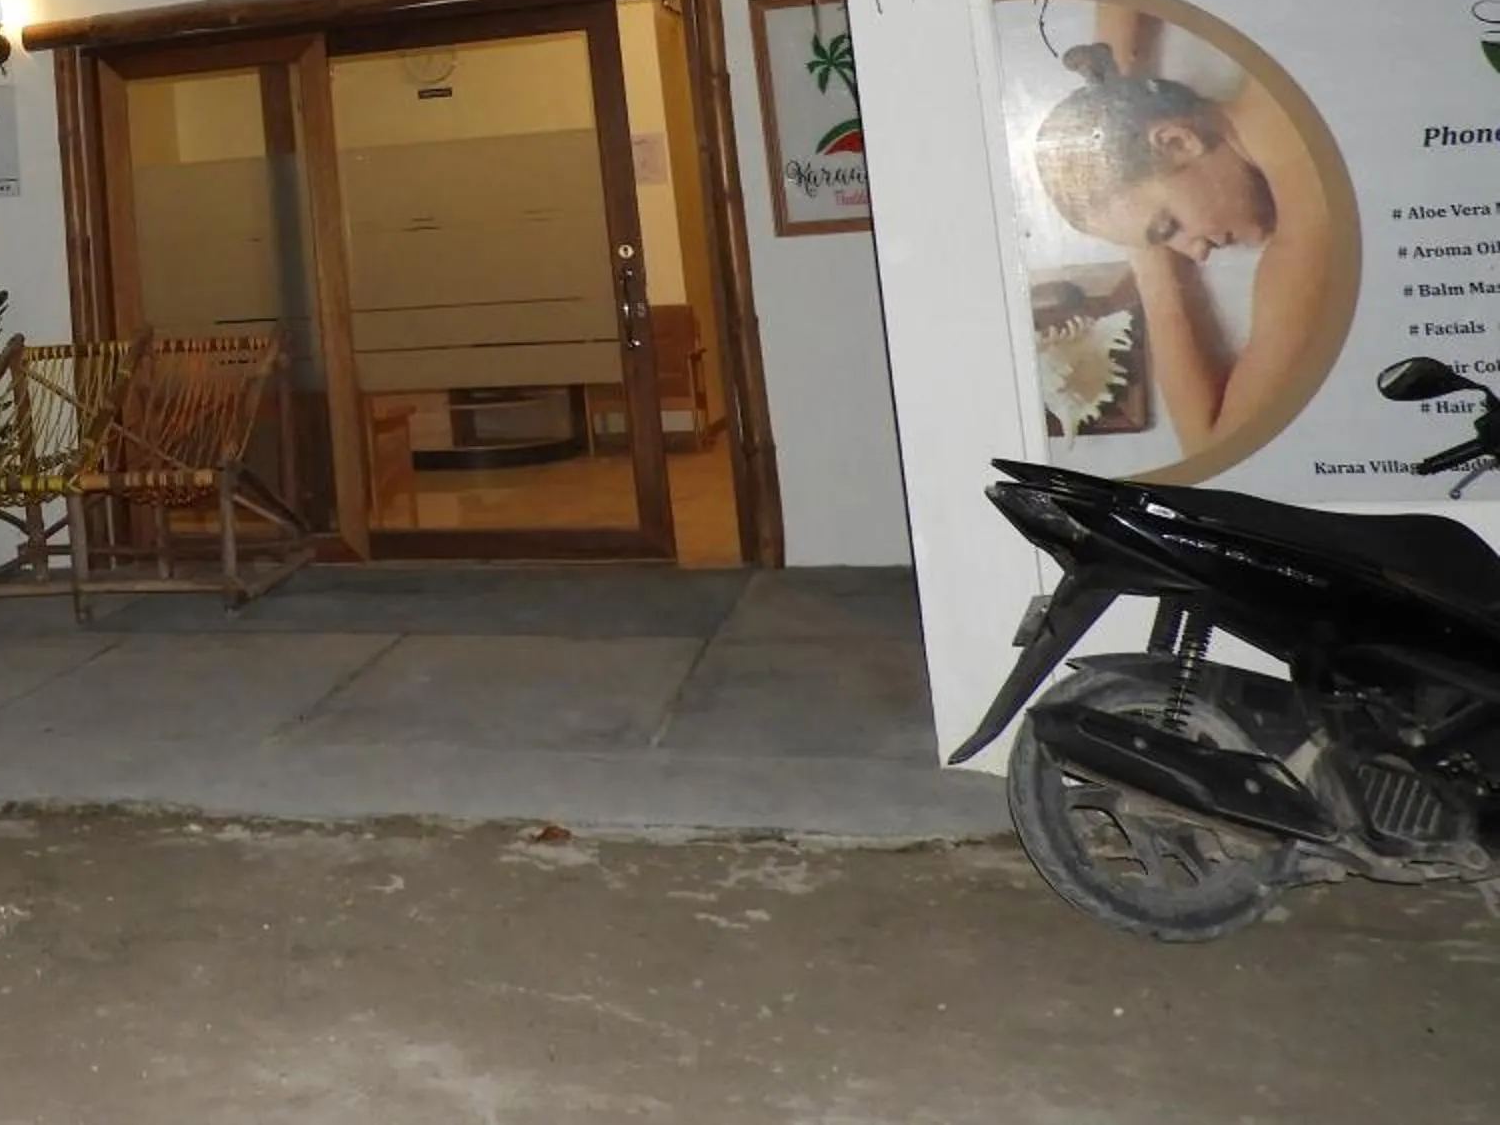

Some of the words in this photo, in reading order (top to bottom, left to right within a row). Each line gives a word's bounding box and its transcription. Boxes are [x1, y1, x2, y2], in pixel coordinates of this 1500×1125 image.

[1408, 206, 1447, 220] Aloe
[1450, 204, 1491, 217] Vera
[1414, 245, 1472, 258] Aroma
[1419, 283, 1464, 296] Balm
[1425, 321, 1485, 335] Facials
[1436, 401, 1475, 413] Hair
[1314, 461, 1365, 475] Karaa
[1369, 460, 1420, 476] Villag
